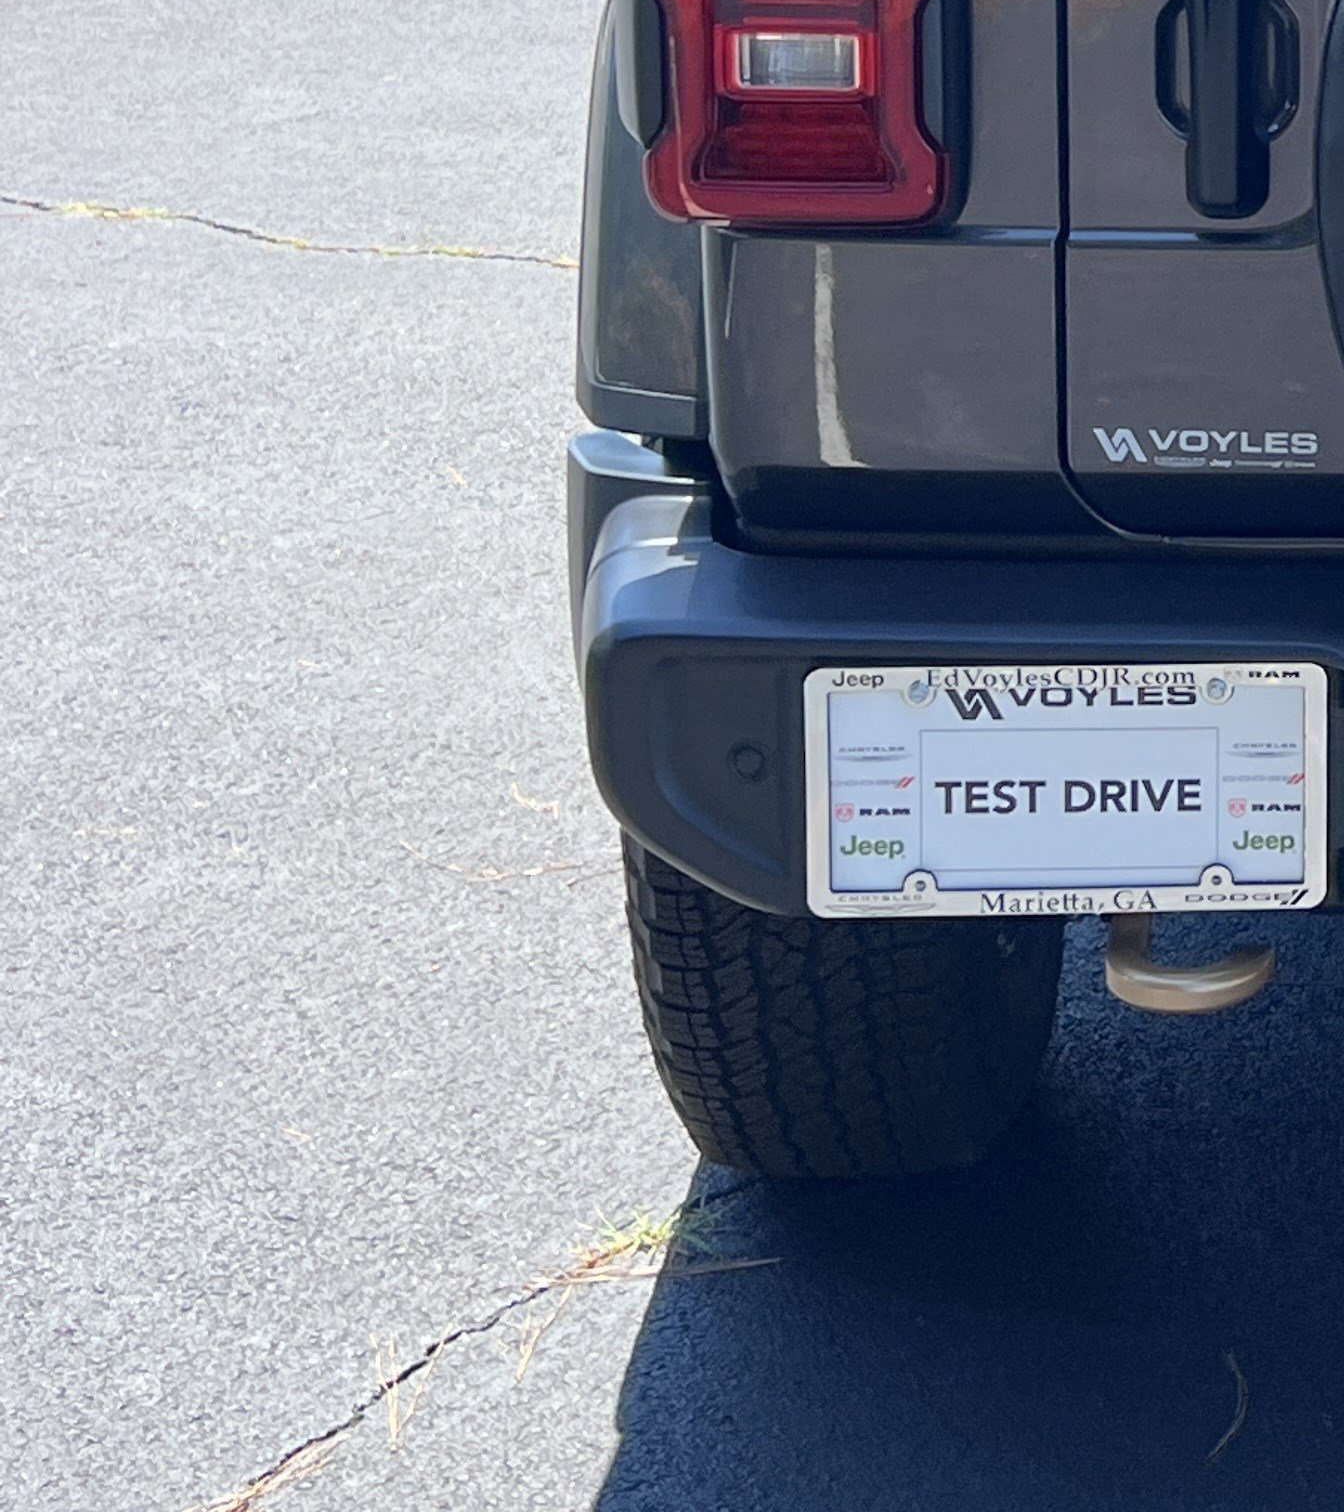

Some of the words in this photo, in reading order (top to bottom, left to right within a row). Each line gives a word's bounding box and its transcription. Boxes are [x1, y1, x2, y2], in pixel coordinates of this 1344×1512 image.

[1148, 428, 1319, 455] VOYLES
[832, 670, 885, 688] Jeep
[926, 666, 1197, 693] EdVoylesCDJR.com
[1008, 685, 1198, 707] VOYLES
[935, 779, 1047, 815] TEST
[1063, 778, 1202, 814] DRIVE
[1251, 803, 1301, 812] RAM
[859, 807, 912, 817] RAM
[840, 834, 905, 859] Jeep
[1232, 830, 1296, 853] Jeep
[980, 890, 1105, 914] Marietta,
[1113, 889, 1158, 911] GA
